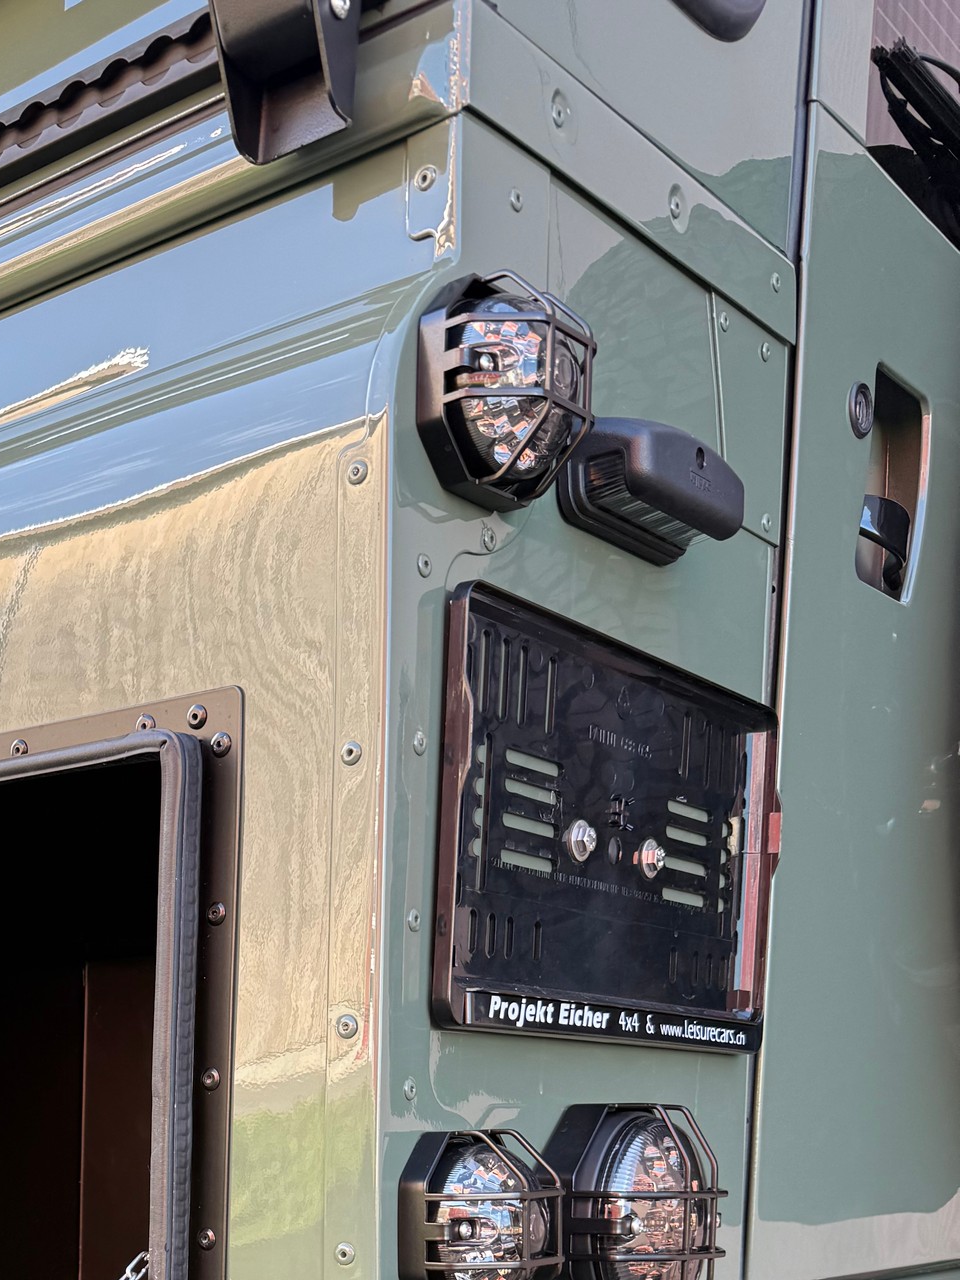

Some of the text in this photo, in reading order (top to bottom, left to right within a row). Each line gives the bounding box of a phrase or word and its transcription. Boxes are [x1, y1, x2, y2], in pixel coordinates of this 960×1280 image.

[488, 995, 747, 1047] Projekt Eicher 4x4 & www.leisurecars.ch
